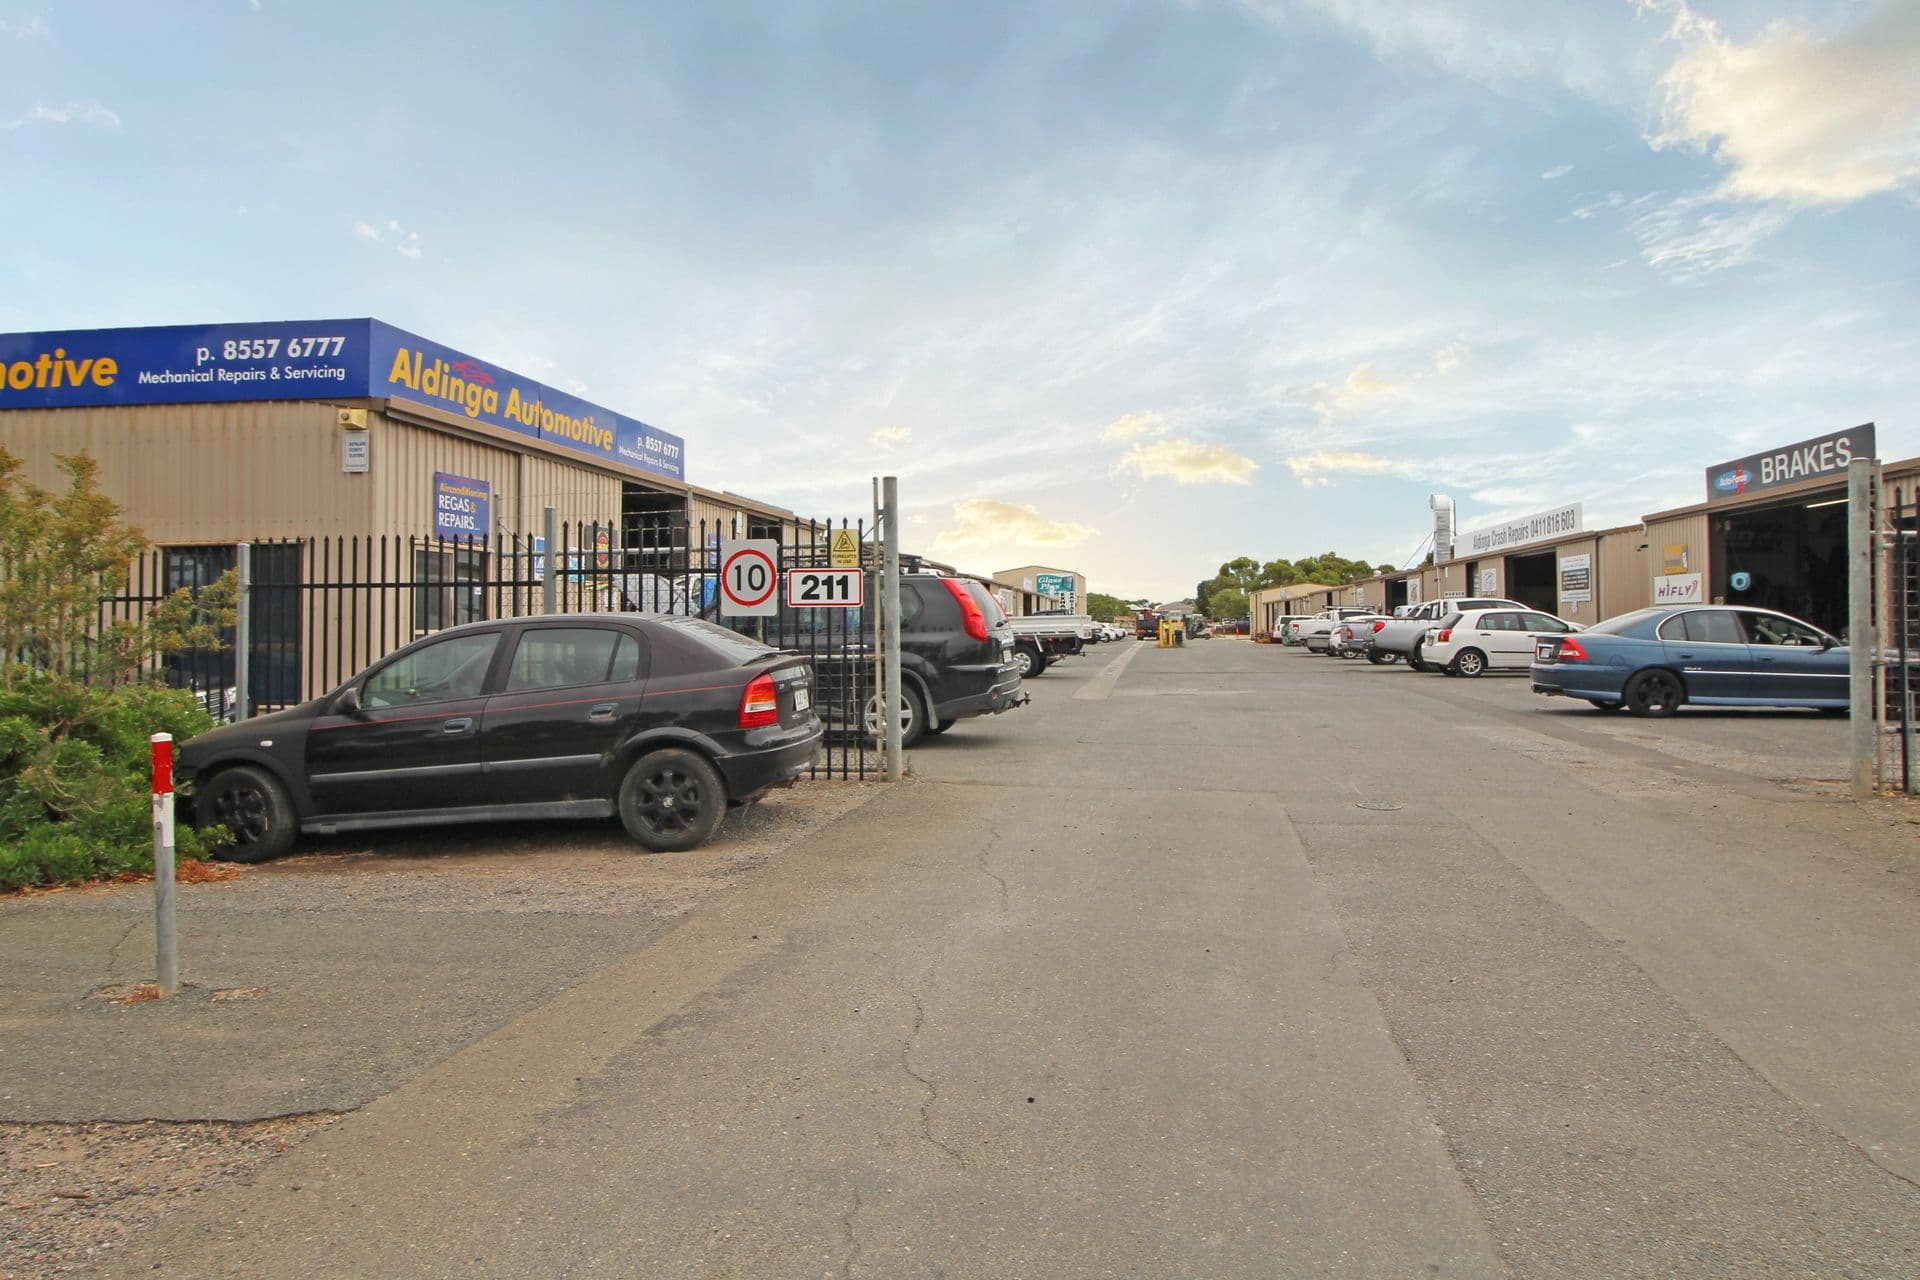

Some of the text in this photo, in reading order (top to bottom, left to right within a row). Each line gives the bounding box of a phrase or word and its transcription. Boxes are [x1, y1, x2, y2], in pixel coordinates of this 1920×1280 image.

[196, 336, 346, 366] p. 8557 6777
[138, 364, 346, 384] Mechanical Repairs & Servicing
[388, 347, 614, 451] Aldinga Automotive
[637, 435, 679, 459] p. 8557 6777
[1761, 437, 1851, 484] BRAKES
[438, 494, 470, 512] REGAS
[1473, 533, 1491, 552] Aldinga
[1491, 528, 1508, 547] Crash
[1507, 523, 1530, 545] Repairs
[1560, 509, 1576, 532] 603
[734, 564, 766, 591] 10
[801, 574, 849, 601] 211
